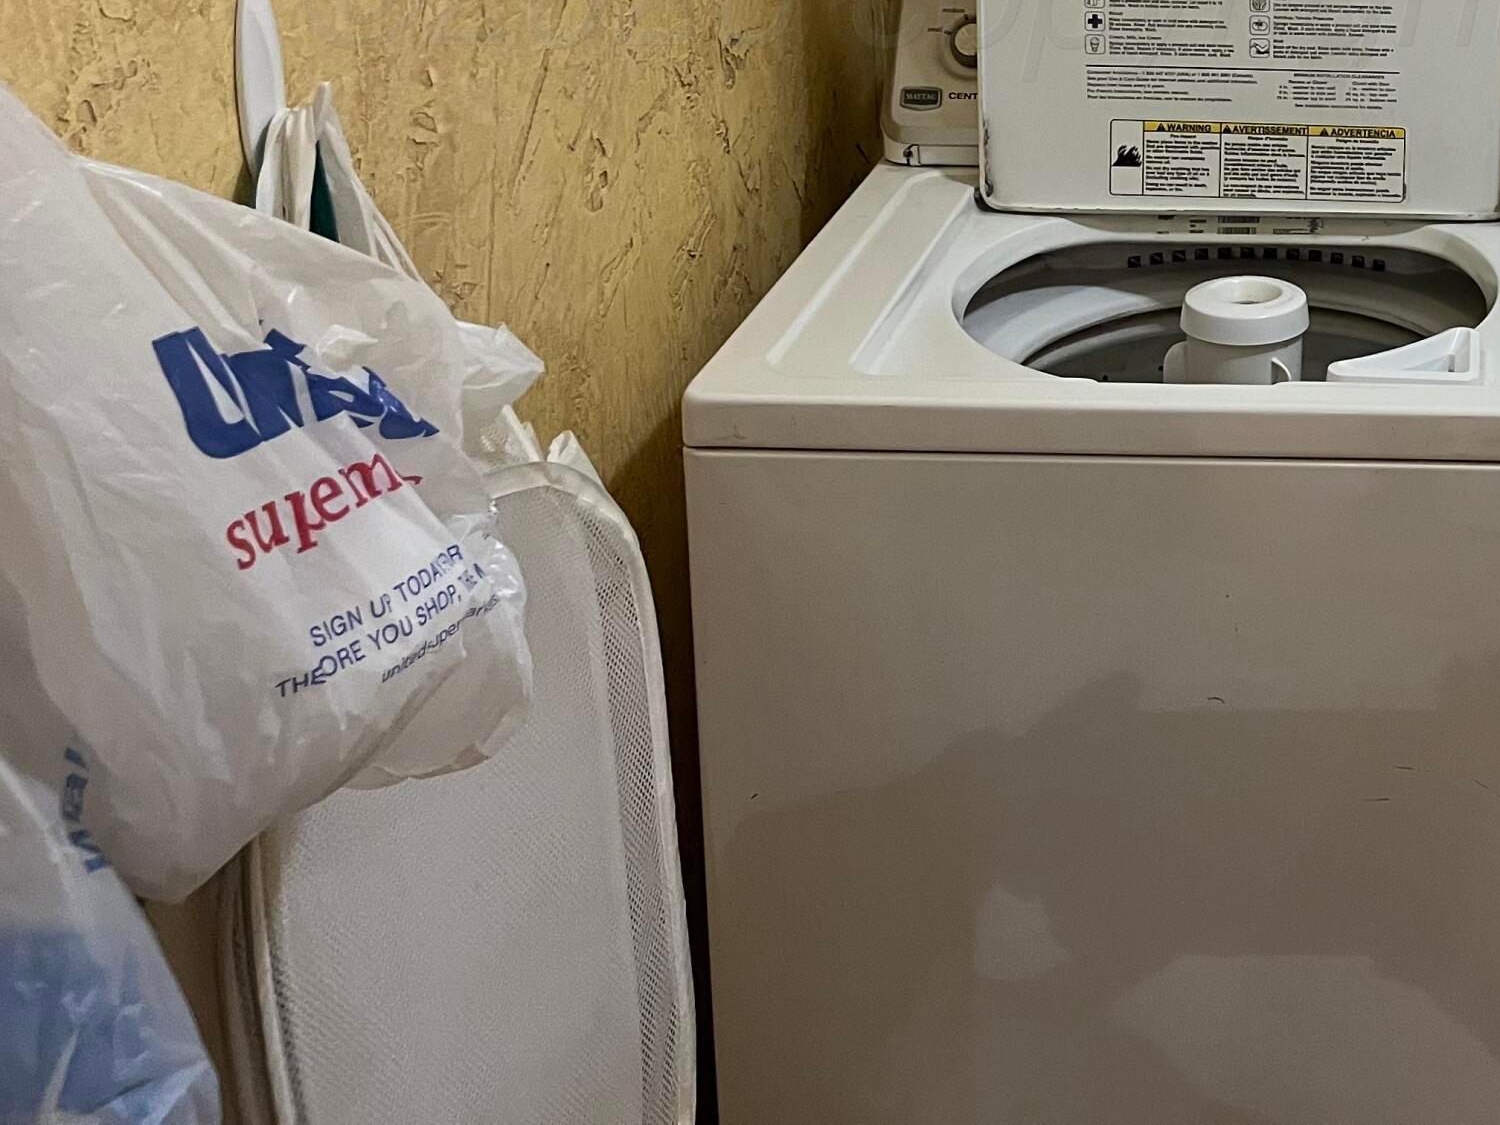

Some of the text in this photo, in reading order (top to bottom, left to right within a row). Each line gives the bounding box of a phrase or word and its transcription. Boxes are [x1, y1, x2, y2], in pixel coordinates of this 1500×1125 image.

[948, 92, 978, 100] CENT
[1167, 123, 1211, 132] WARNING
[1233, 125, 1307, 136] AVERTISSEMENT
[1331, 128, 1396, 138] ADVERTENCIA
[368, 616, 413, 650] YOU
[416, 584, 462, 626] SHOP,
[310, 606, 363, 647] SIGN
